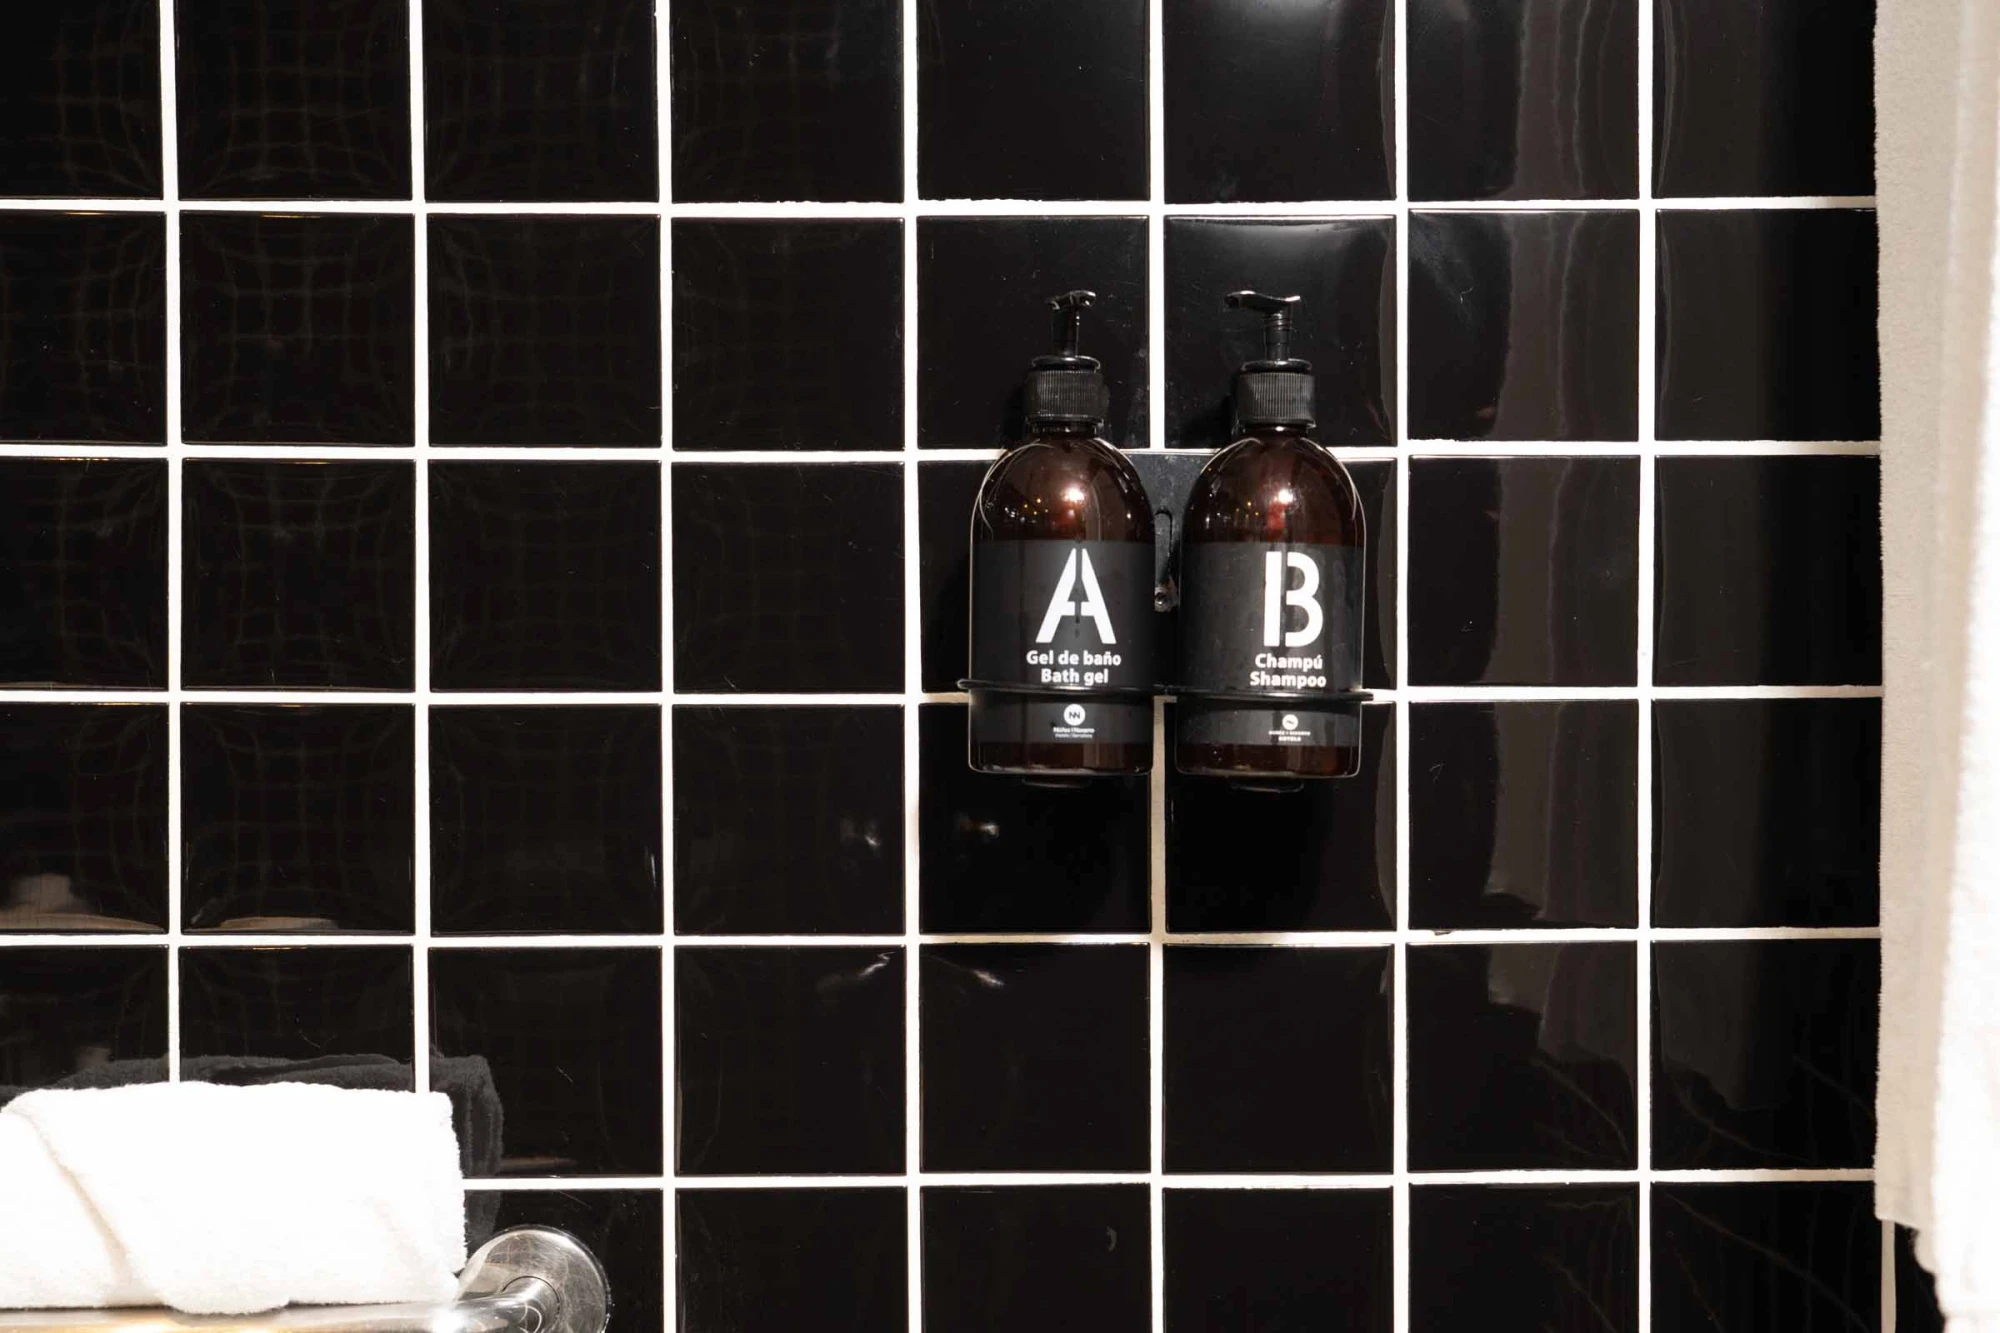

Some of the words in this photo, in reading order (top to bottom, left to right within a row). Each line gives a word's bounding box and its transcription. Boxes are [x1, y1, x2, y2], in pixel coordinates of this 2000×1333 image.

[1035, 548, 1117, 644] A
[1263, 551, 1323, 647] B
[1026, 650, 1054, 665] Gel
[1058, 650, 1079, 665] de
[1083, 651, 1122, 666] baño
[1255, 653, 1323, 672] Champú
[1041, 668, 1079, 683] Bath
[1084, 669, 1109, 686] gel
[1249, 671, 1327, 689] Shampoo
